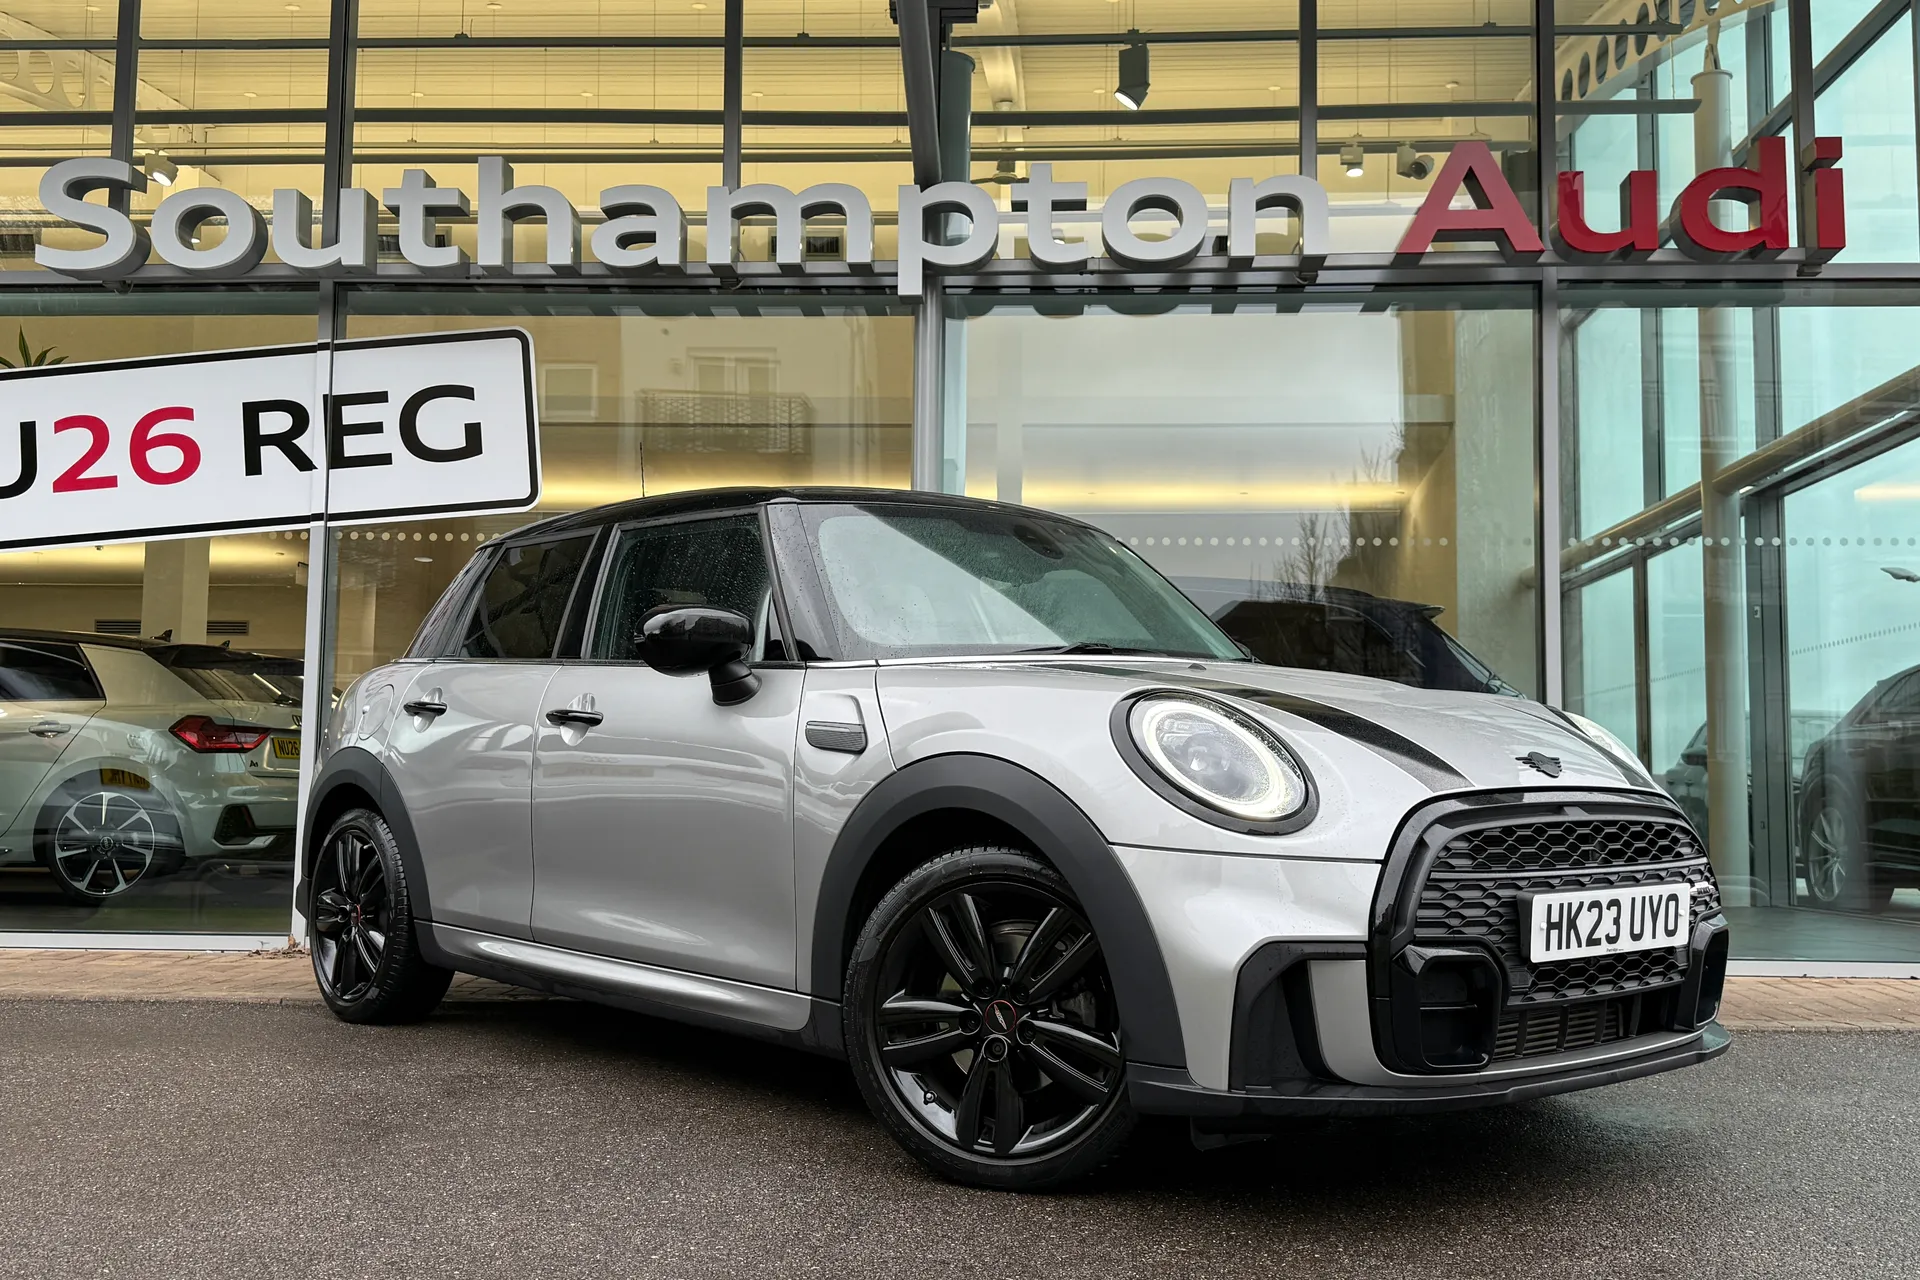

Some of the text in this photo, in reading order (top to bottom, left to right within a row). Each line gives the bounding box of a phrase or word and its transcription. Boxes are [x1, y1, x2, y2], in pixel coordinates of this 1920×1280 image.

[34, 136, 1846, 298] Southampton Audi
[241, 384, 484, 477] REG
[1545, 898, 1622, 952] HK23
